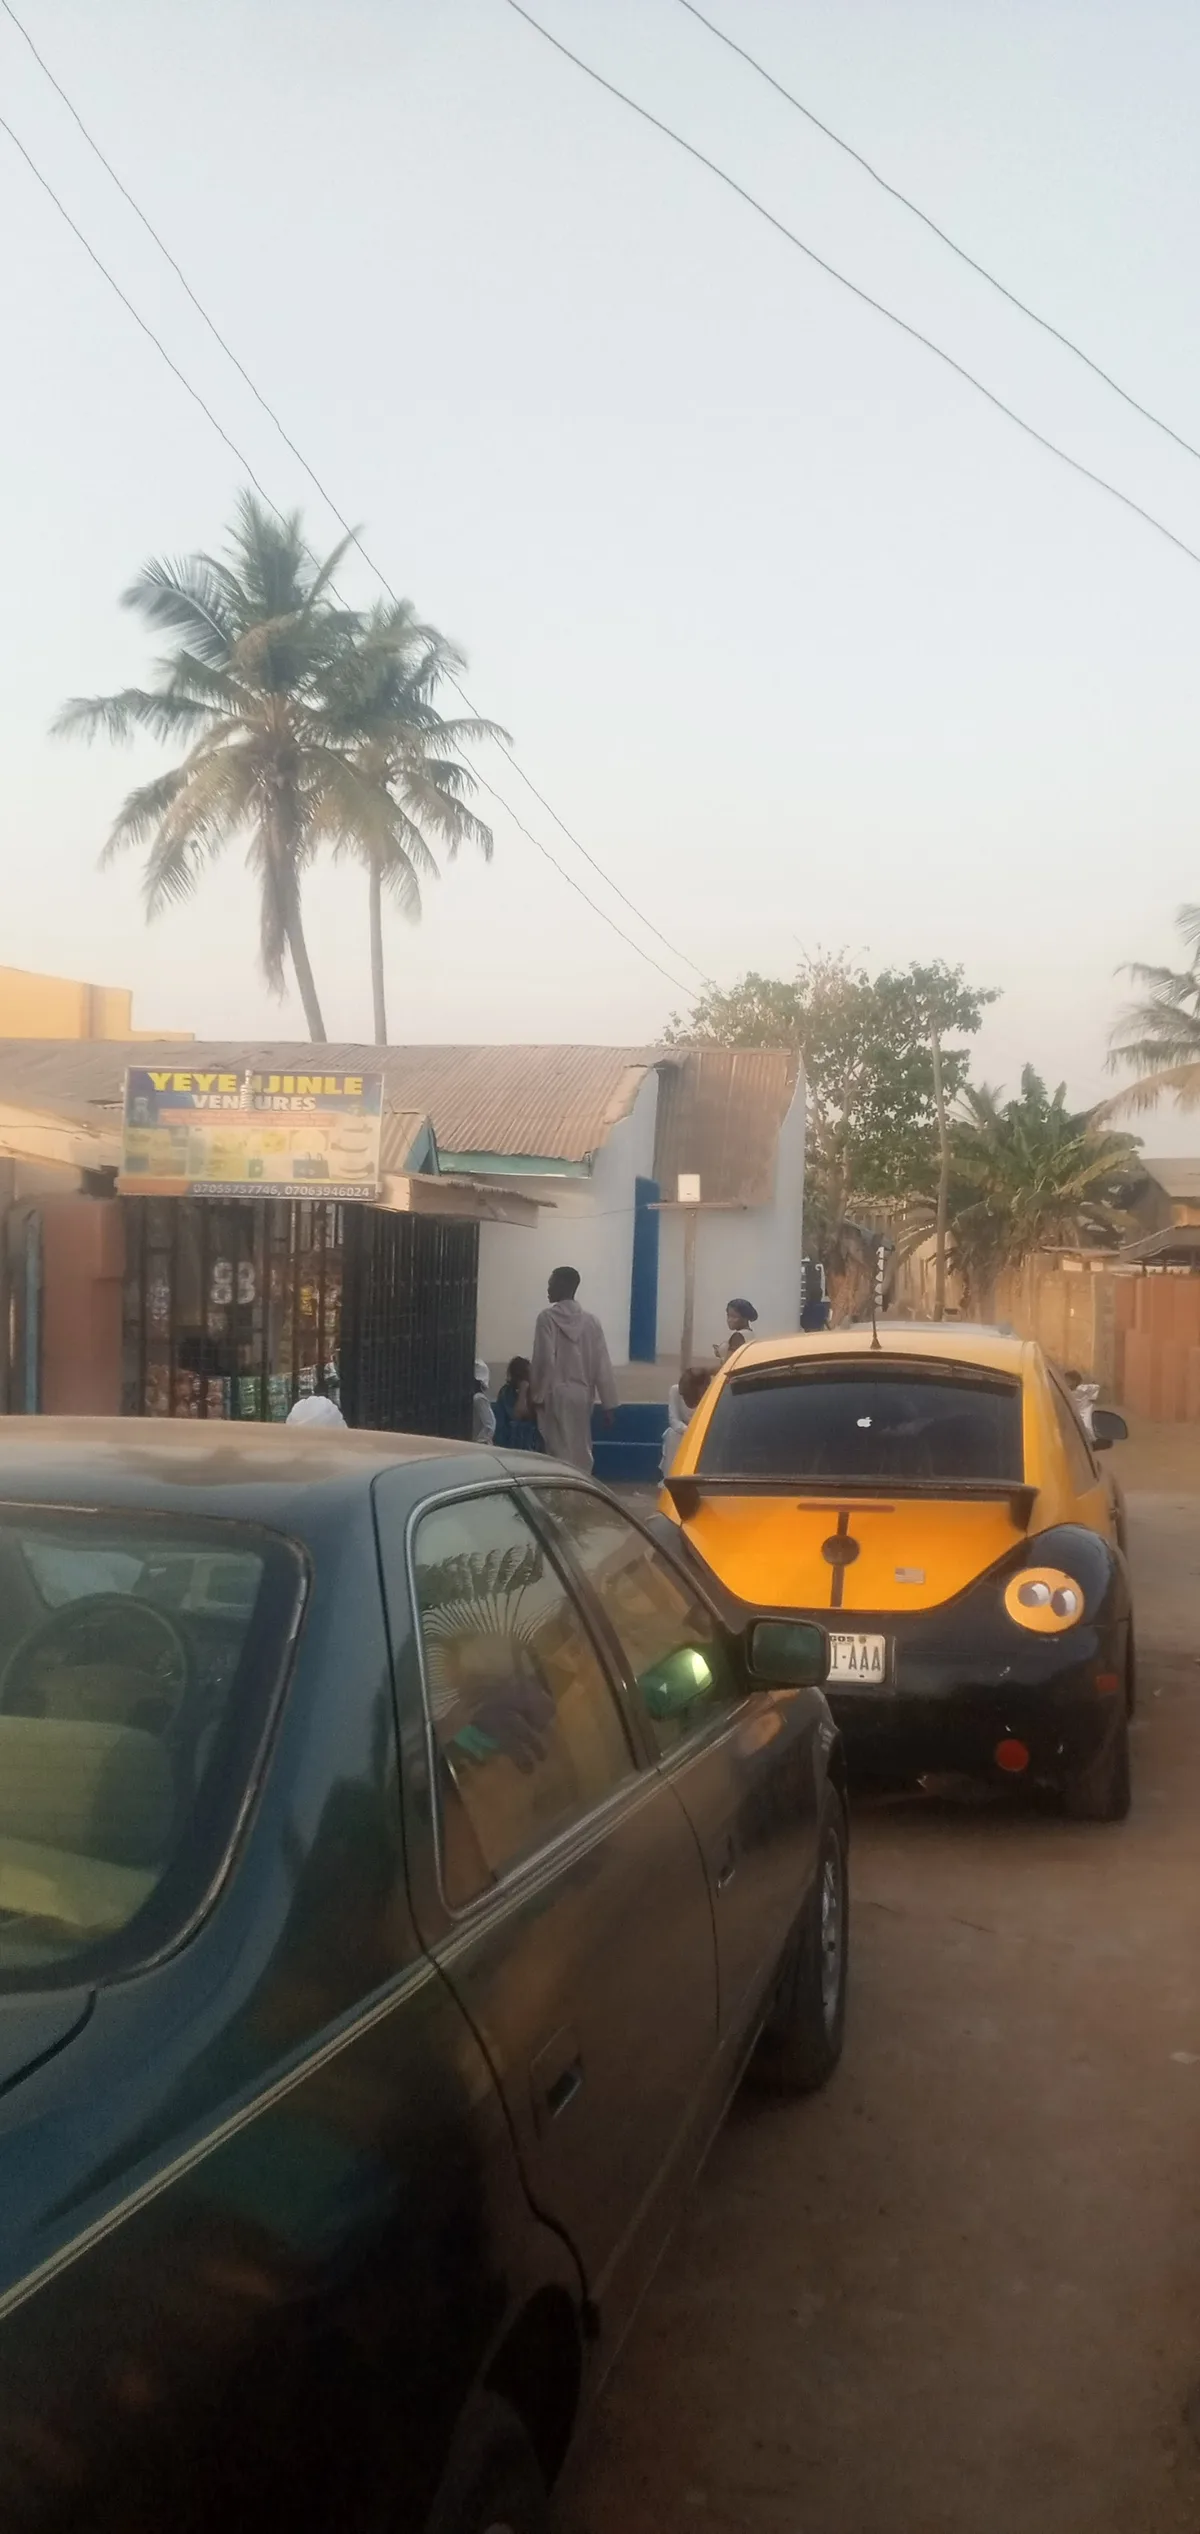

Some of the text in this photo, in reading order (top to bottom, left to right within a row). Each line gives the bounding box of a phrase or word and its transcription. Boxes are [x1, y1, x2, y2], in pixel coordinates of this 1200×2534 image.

[148, 1072, 237, 1092] YEYE
[192, 1094, 316, 1111] VENURES
[284, 1185, 370, 1197] 07063946024
